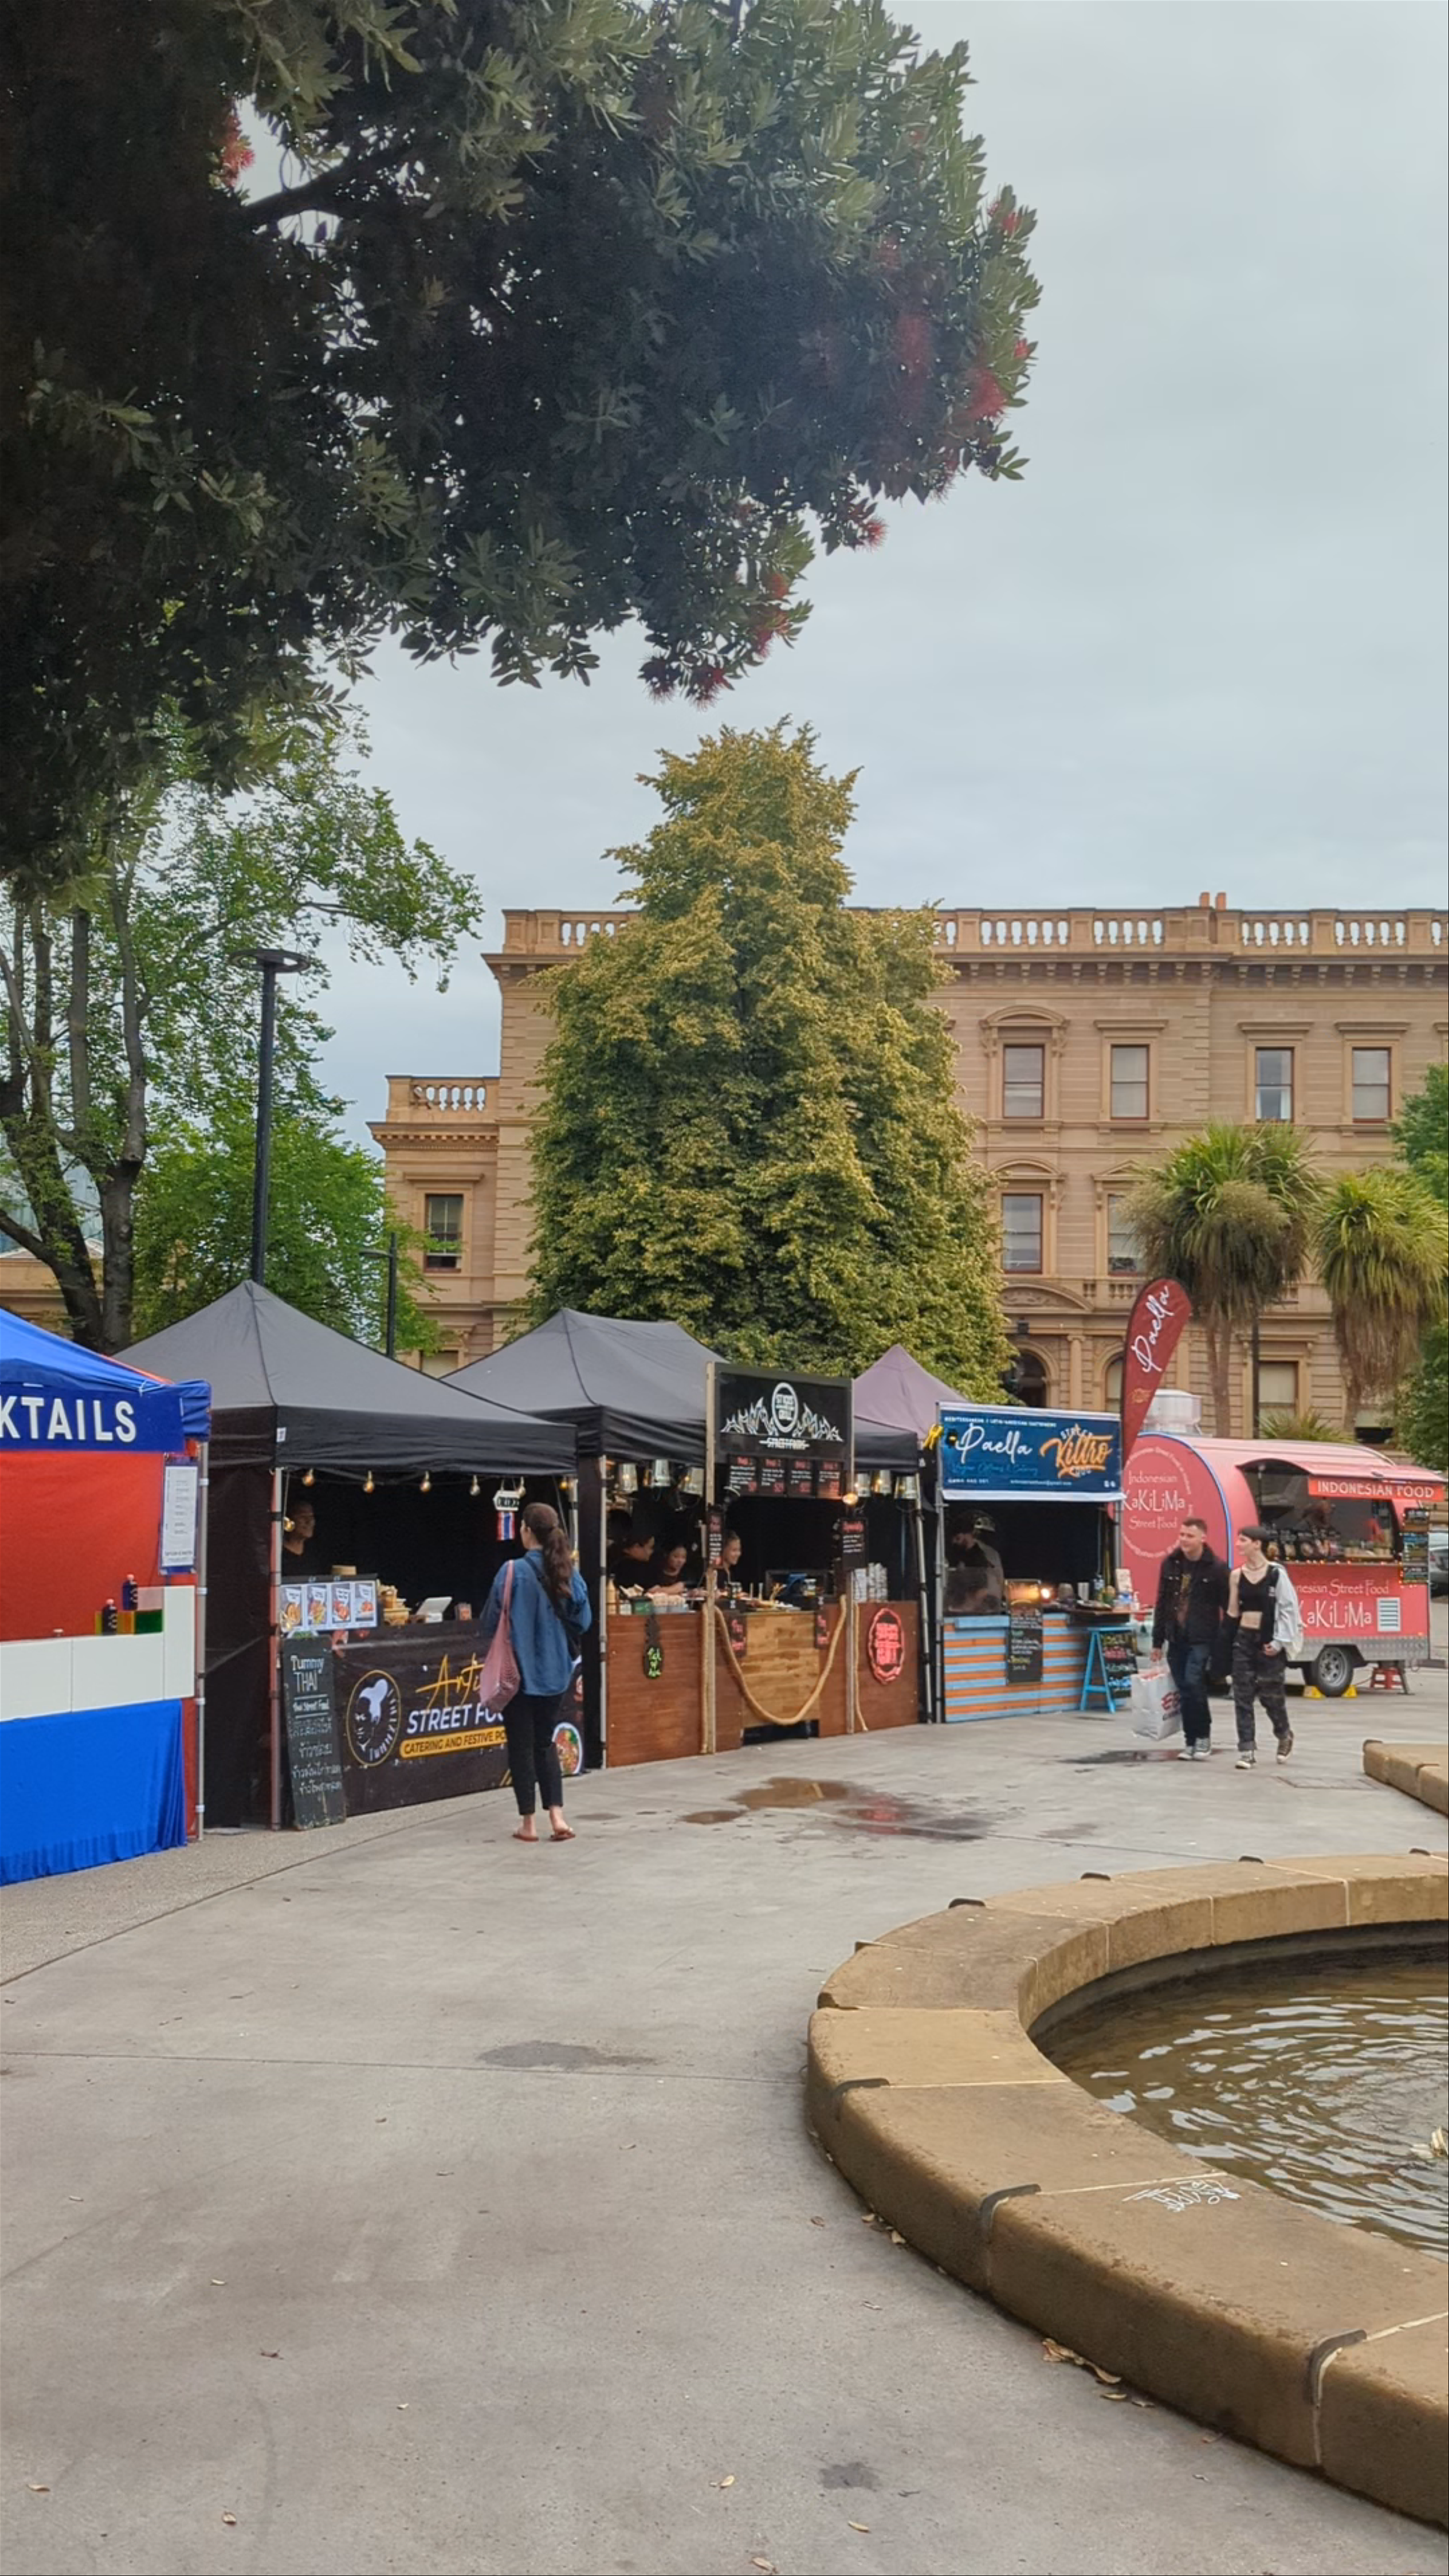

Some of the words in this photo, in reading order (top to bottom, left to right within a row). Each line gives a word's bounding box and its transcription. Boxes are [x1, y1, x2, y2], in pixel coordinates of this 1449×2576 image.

[1131, 1286, 1174, 1372] Paella
[0, 1396, 137, 1443] KTAILS
[955, 1423, 1032, 1464] Paella
[1129, 1470, 1177, 1485] Indonesian
[1317, 1481, 1393, 1496] INDONESIAN
[1397, 1485, 1434, 1498] FOOD
[1129, 1515, 1155, 1529] Street
[1157, 1515, 1178, 1530] Food
[1297, 1581, 1327, 1594] nesian
[1328, 1578, 1363, 1597] Street
[1364, 1579, 1389, 1596] Food
[406, 1703, 472, 1734] STREET
[404, 1741, 445, 1755] CATERING
[445, 1738, 462, 1749] AND
[463, 1732, 493, 1746] FESTIVE
